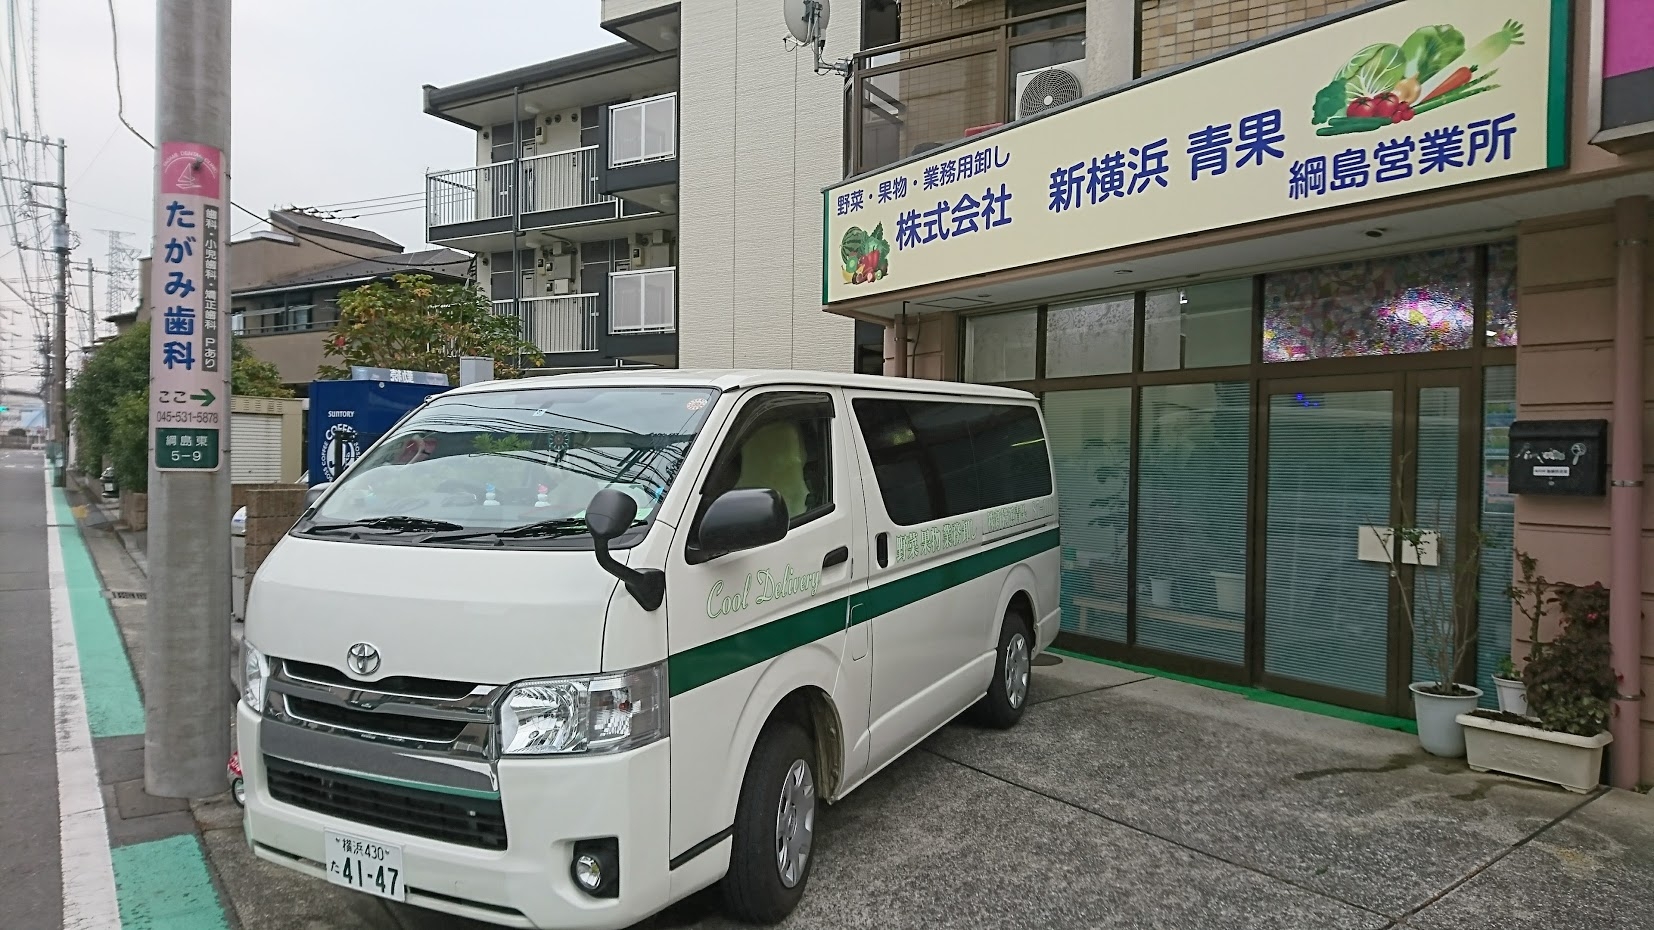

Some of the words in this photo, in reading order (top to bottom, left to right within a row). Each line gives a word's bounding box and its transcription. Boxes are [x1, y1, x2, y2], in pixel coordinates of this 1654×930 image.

[895, 183, 1013, 250] 株式会社
[1048, 138, 1169, 213] 新横浜
[1186, 108, 1286, 181] 青果
[1288, 112, 1517, 200] 綱島営業所
[837, 145, 1011, 216] 野菜・果物・業務用卸し
[163, 200, 196, 371] たがみ歯科
[156, 410, 219, 424] 045-531-5878
[158, 390, 187, 404] ここ
[165, 435, 208, 447] 綱島東
[706, 579, 753, 619] Cool
[755, 564, 820, 605] Delivery
[342, 838, 364, 856] 横浜
[364, 843, 384, 861] 430
[343, 857, 399, 895] 41-47
